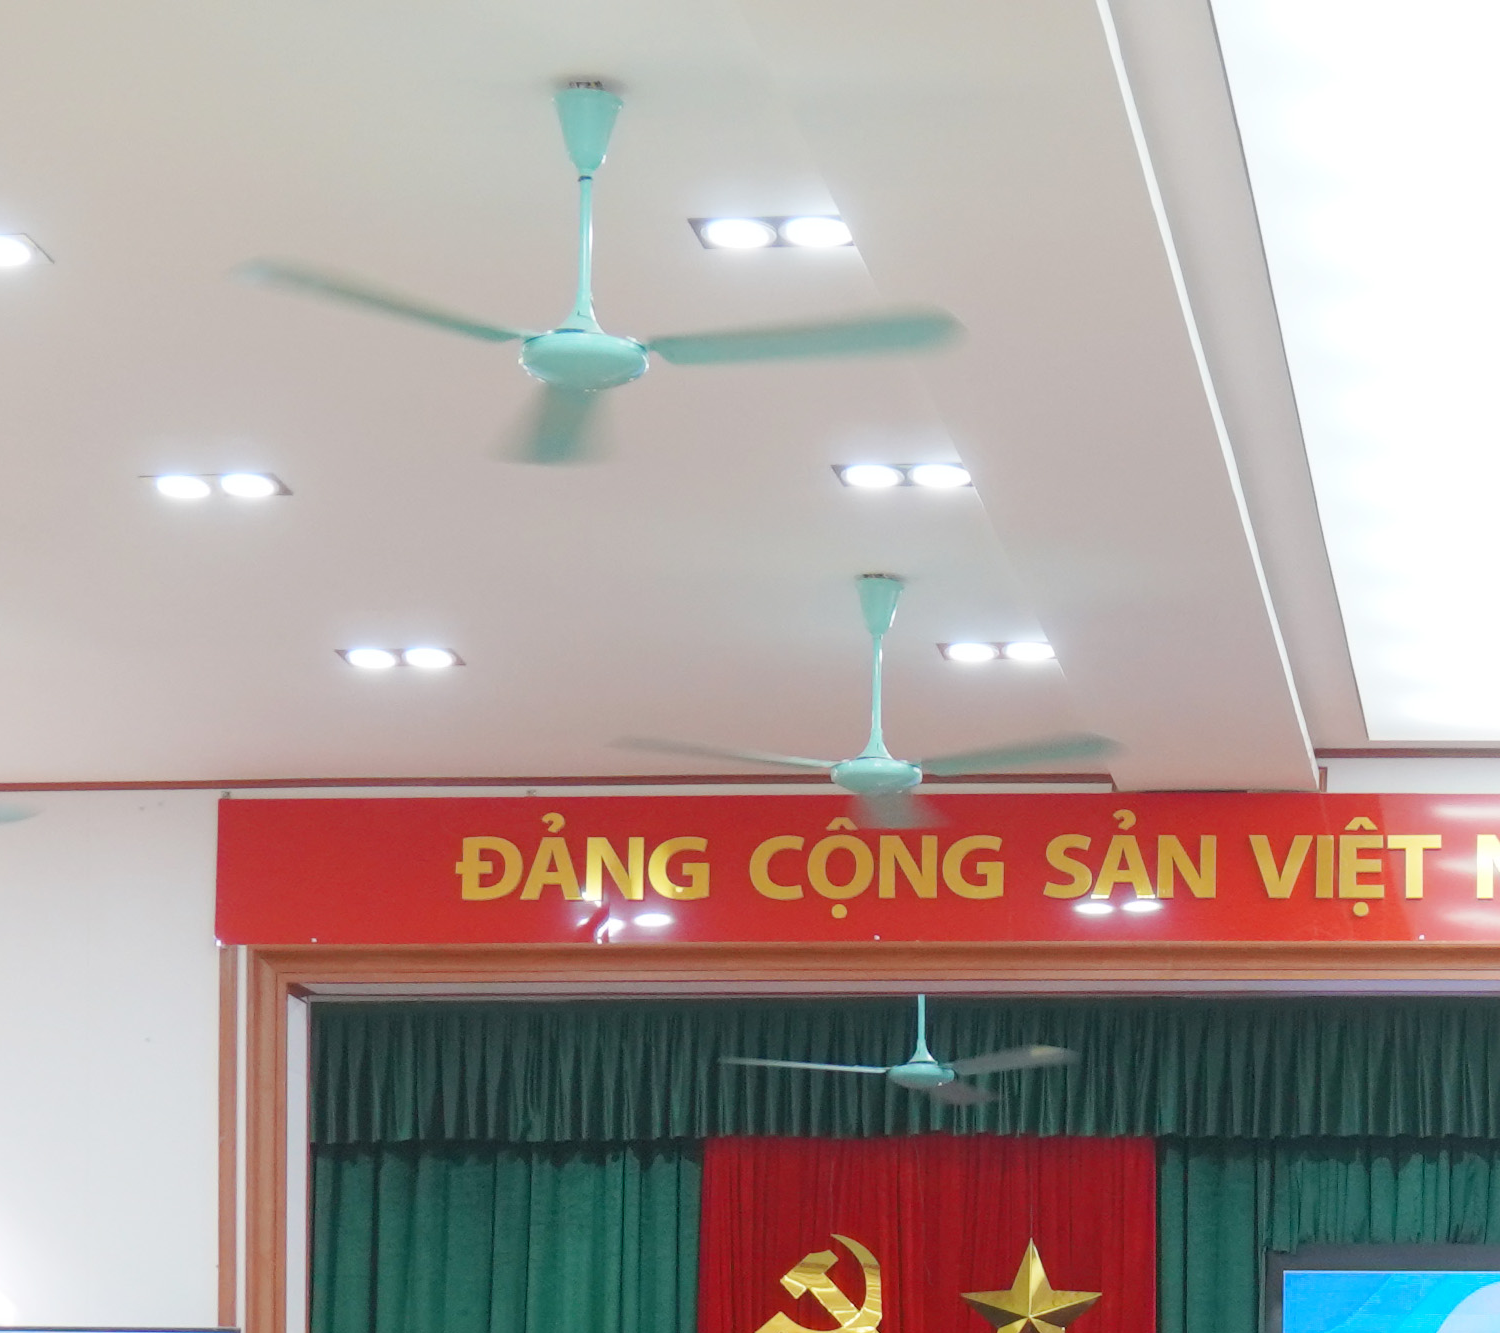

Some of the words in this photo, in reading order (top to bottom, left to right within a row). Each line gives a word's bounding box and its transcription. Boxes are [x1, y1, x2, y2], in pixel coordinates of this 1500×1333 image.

[455, 813, 711, 902] ĐẢNG
[748, 819, 1005, 918] CỘNG
[1043, 809, 1218, 899] SẢN
[1249, 817, 1441, 918] VIỆT
